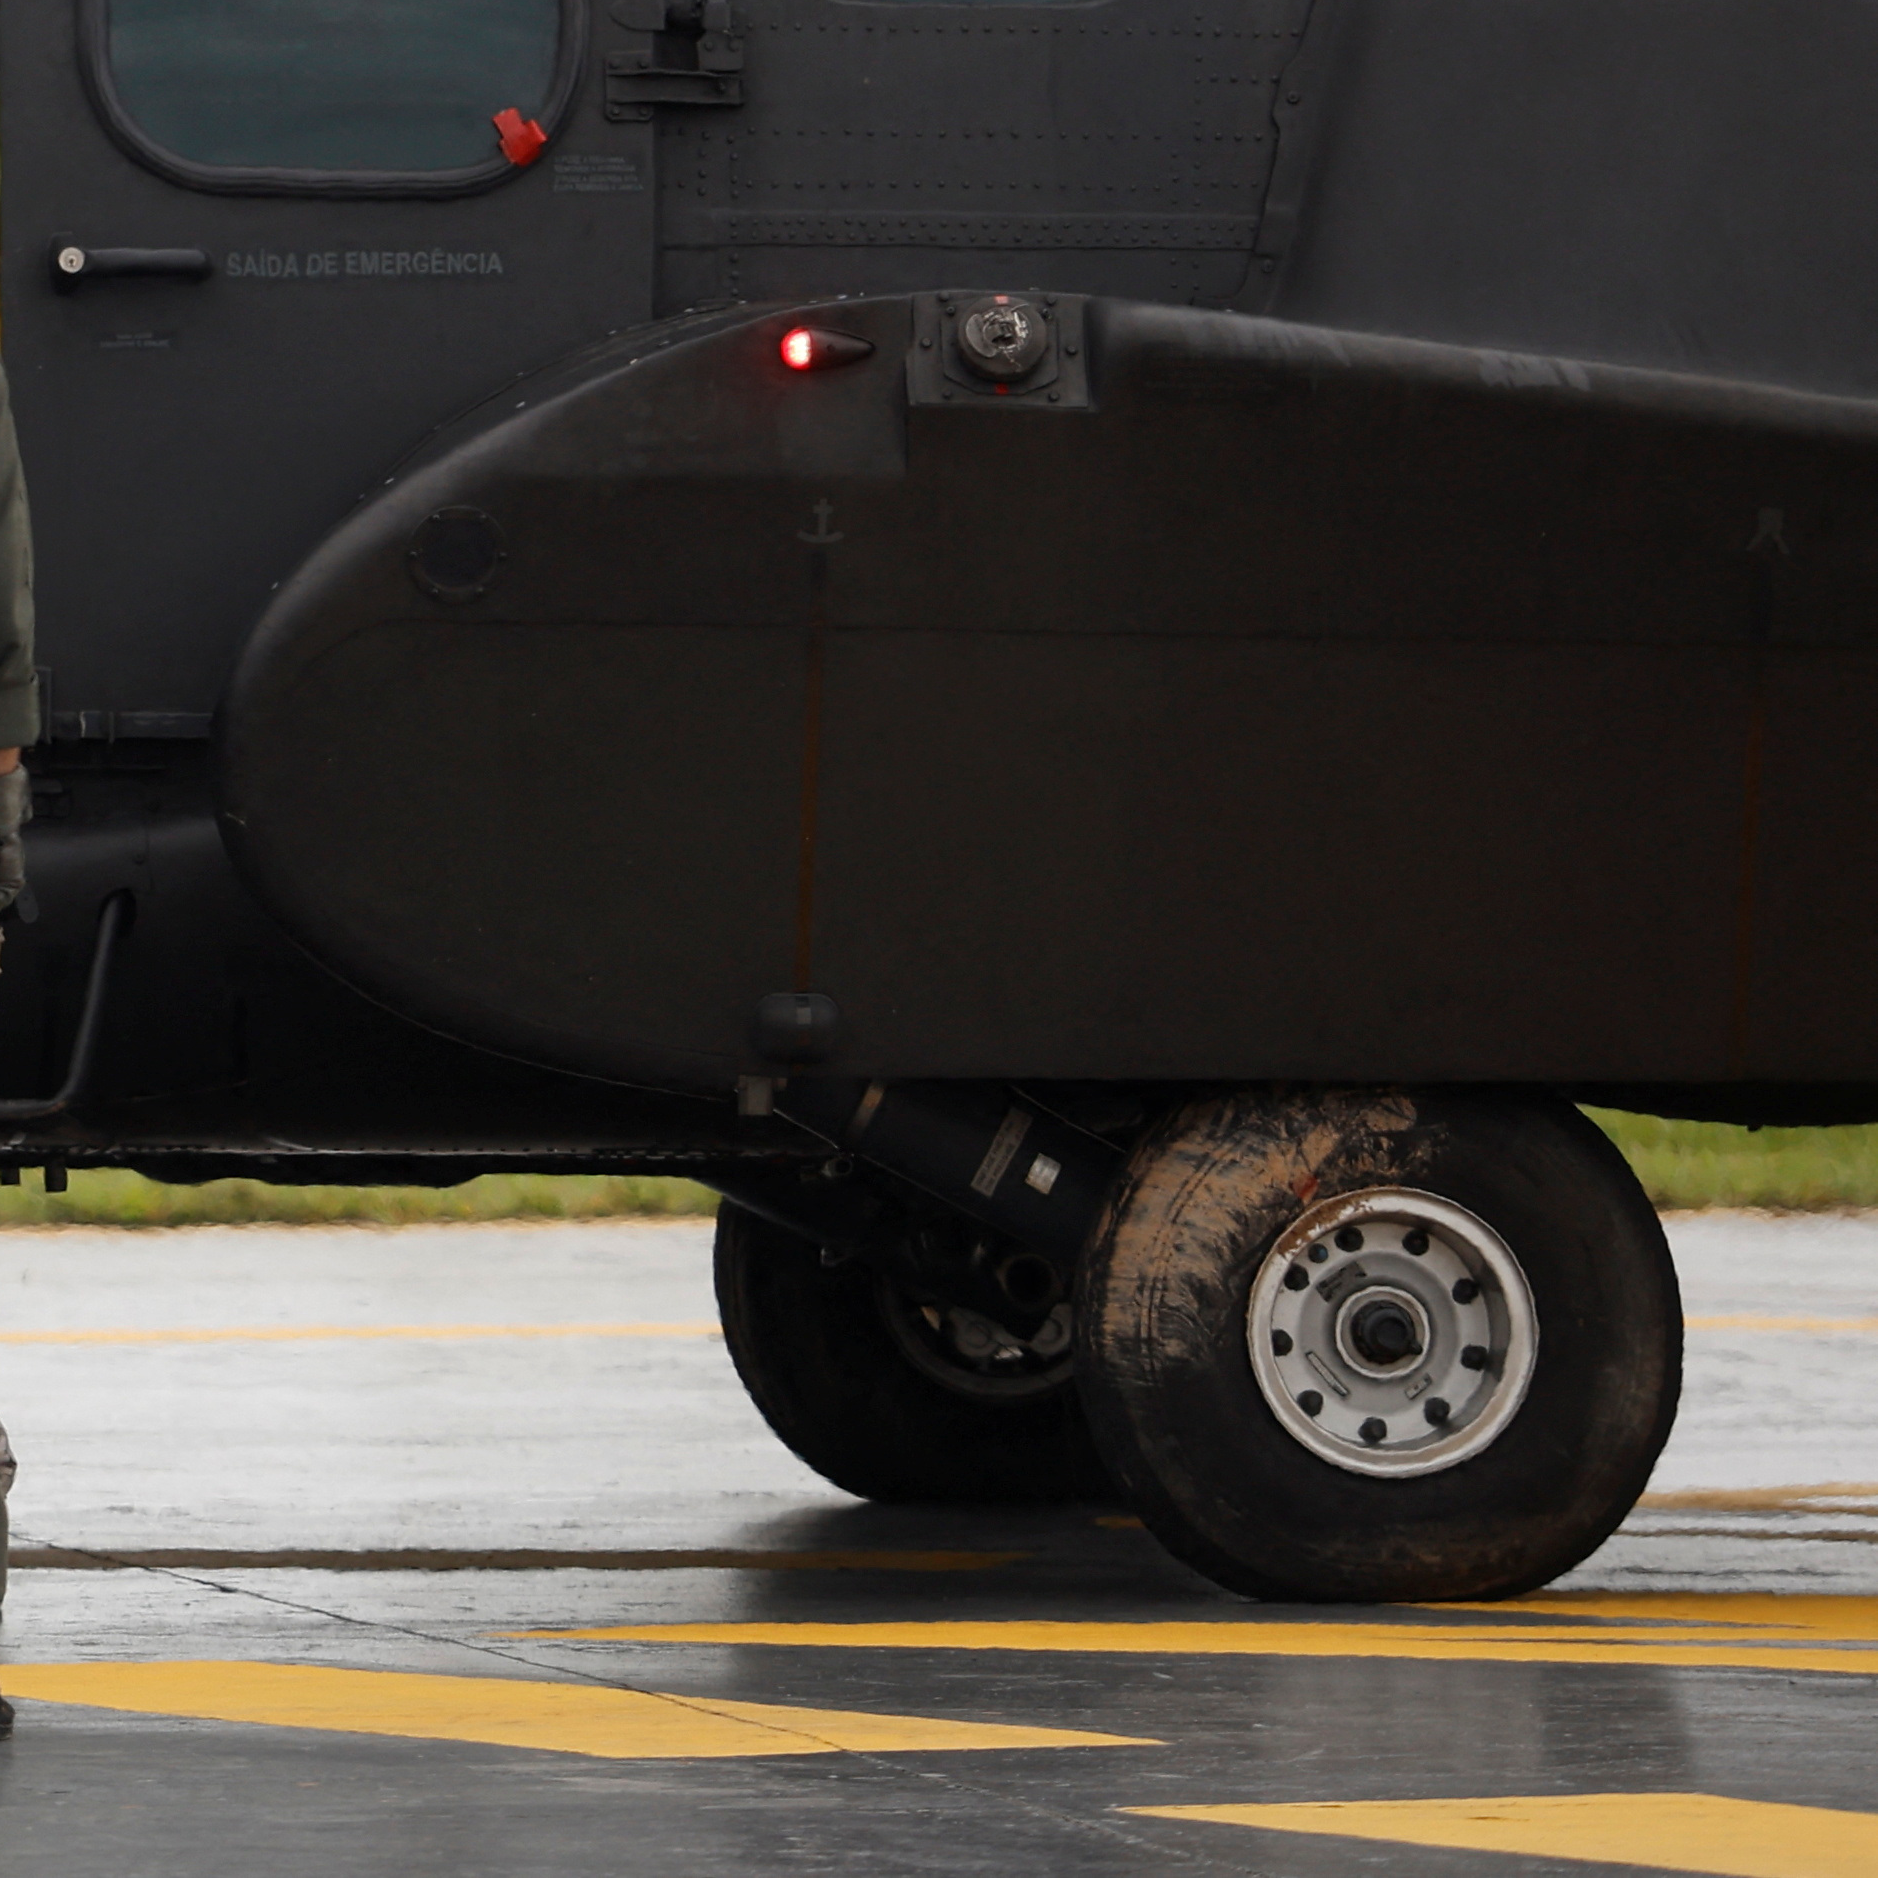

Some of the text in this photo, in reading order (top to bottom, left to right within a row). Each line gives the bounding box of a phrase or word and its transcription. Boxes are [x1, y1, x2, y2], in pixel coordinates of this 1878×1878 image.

[225, 247, 504, 278] SAÍDA DE EMERGÊNCIA
